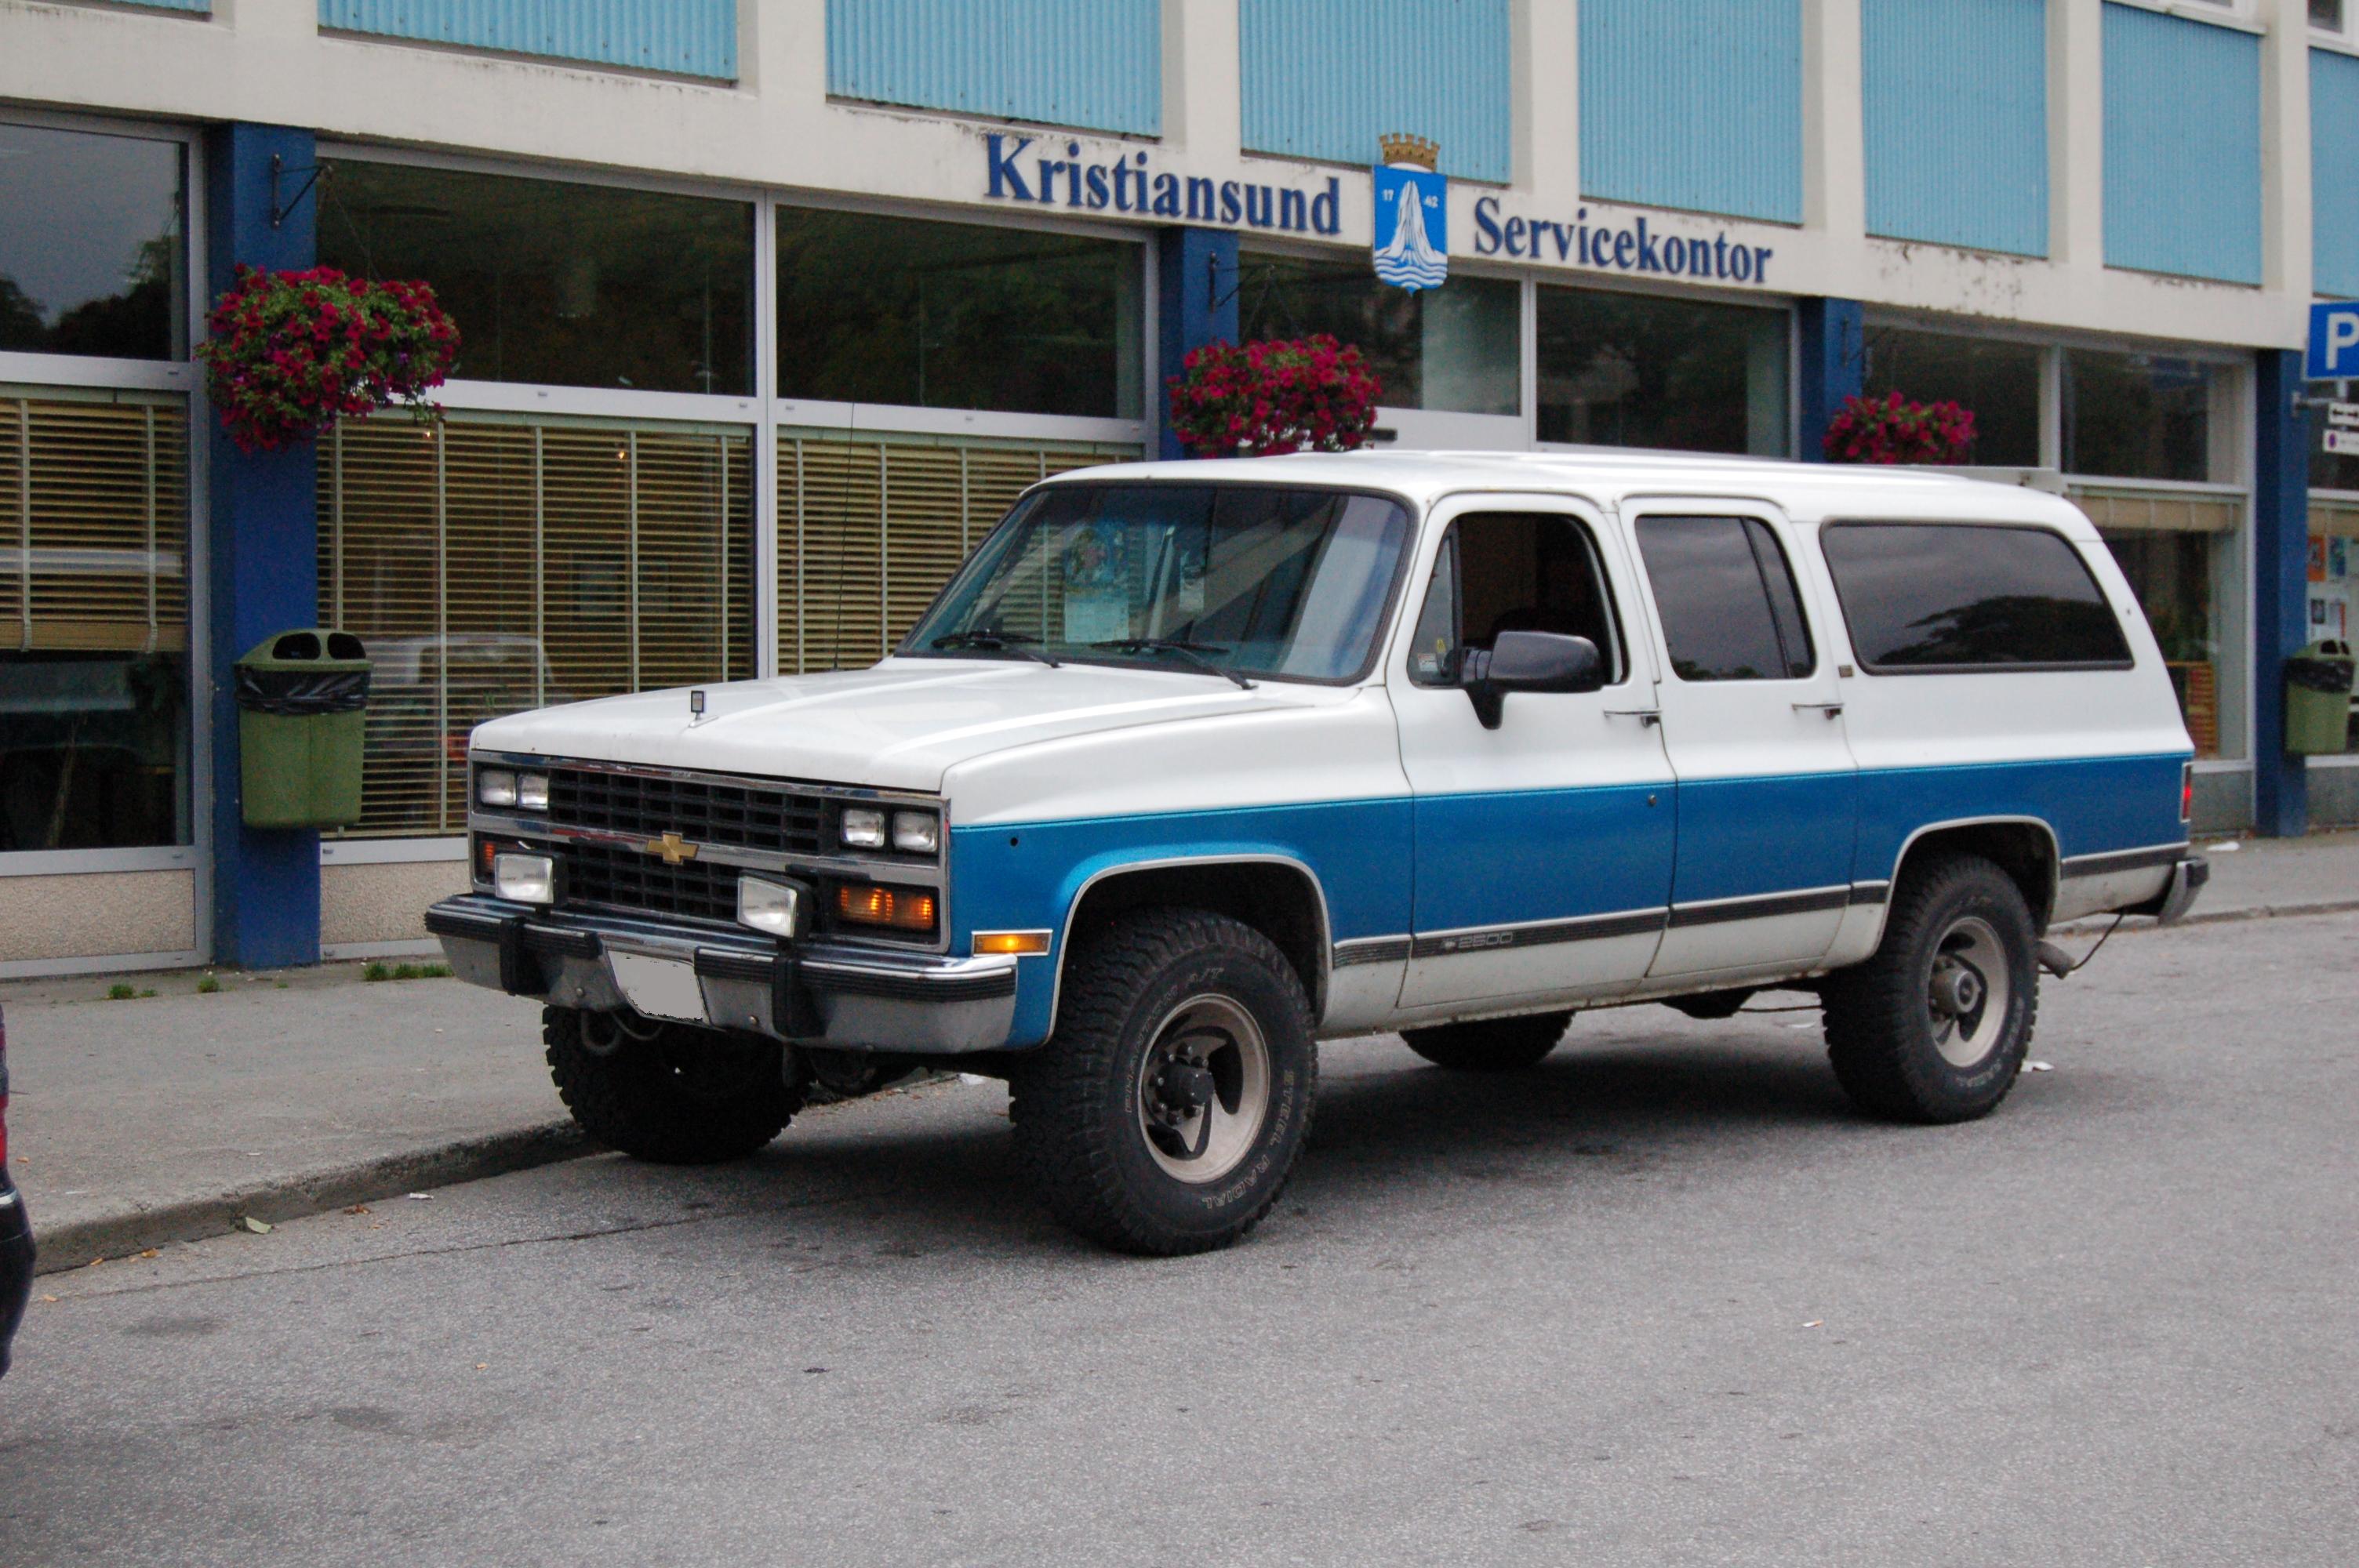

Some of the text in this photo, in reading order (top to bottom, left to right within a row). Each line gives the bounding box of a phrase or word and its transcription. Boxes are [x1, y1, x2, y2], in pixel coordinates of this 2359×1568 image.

[984, 132, 1772, 283] Kristiansund Servicekontor
[1383, 189, 1394, 201] 17
[2325, 311, 2359, 371] P
[1202, 1069, 1295, 1210] STEEL RADIAL
